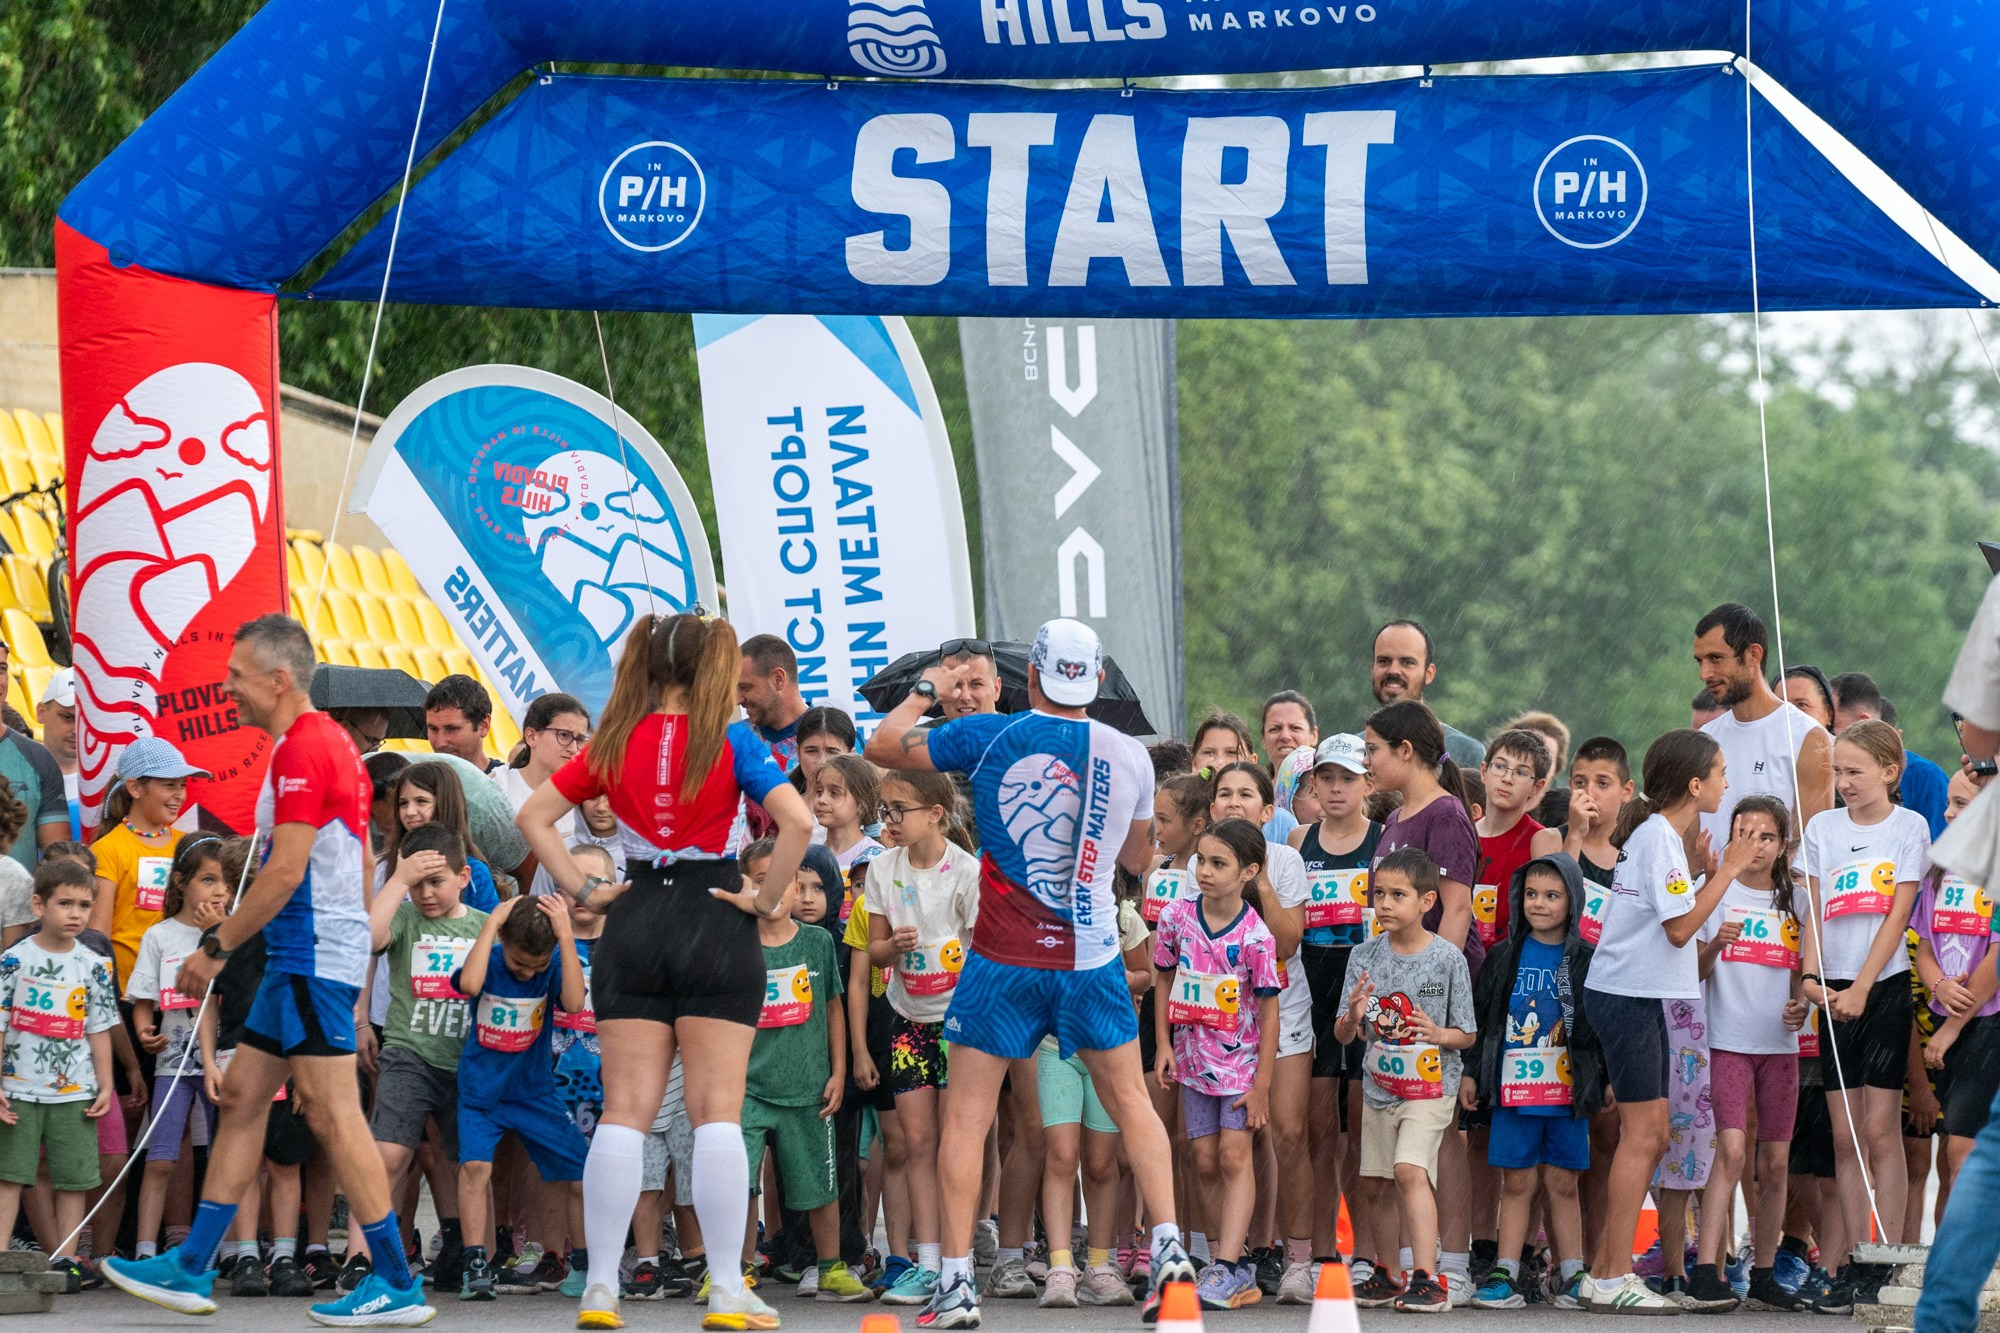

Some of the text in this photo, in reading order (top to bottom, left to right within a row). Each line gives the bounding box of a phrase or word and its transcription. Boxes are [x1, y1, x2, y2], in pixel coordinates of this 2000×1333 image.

[981, 0, 1167, 45] HILLS
[1188, 4, 1377, 31] MARKOVO
[648, 163, 661, 171] IN
[1583, 158, 1598, 166] IN
[619, 176, 687, 210] P/H
[845, 110, 1397, 286] START
[1555, 170, 1626, 207] P/H
[618, 214, 685, 223] MARKOVO
[1554, 210, 1627, 220] MARKOVO
[131, 630, 224, 732] PLOVDIV HILLS IN
[177, 708, 241, 743] HILLS
[243, 733, 268, 768] RACE
[1074, 756, 1110, 926] EVERY STEP MATTERS
[1155, 879, 1178, 899] 61
[1311, 881, 1338, 901] 62
[1834, 871, 1859, 892] 48
[1587, 897, 1603, 915] 4
[1944, 886, 1964, 906] 97
[428, 953, 454, 972] 27
[25, 987, 54, 1010] 36
[1183, 982, 1200, 1002] 11
[491, 1007, 518, 1027] 81
[1378, 1054, 1404, 1075] 60
[1515, 1059, 1544, 1079] 39
[352, 1294, 392, 1316] HOKA
